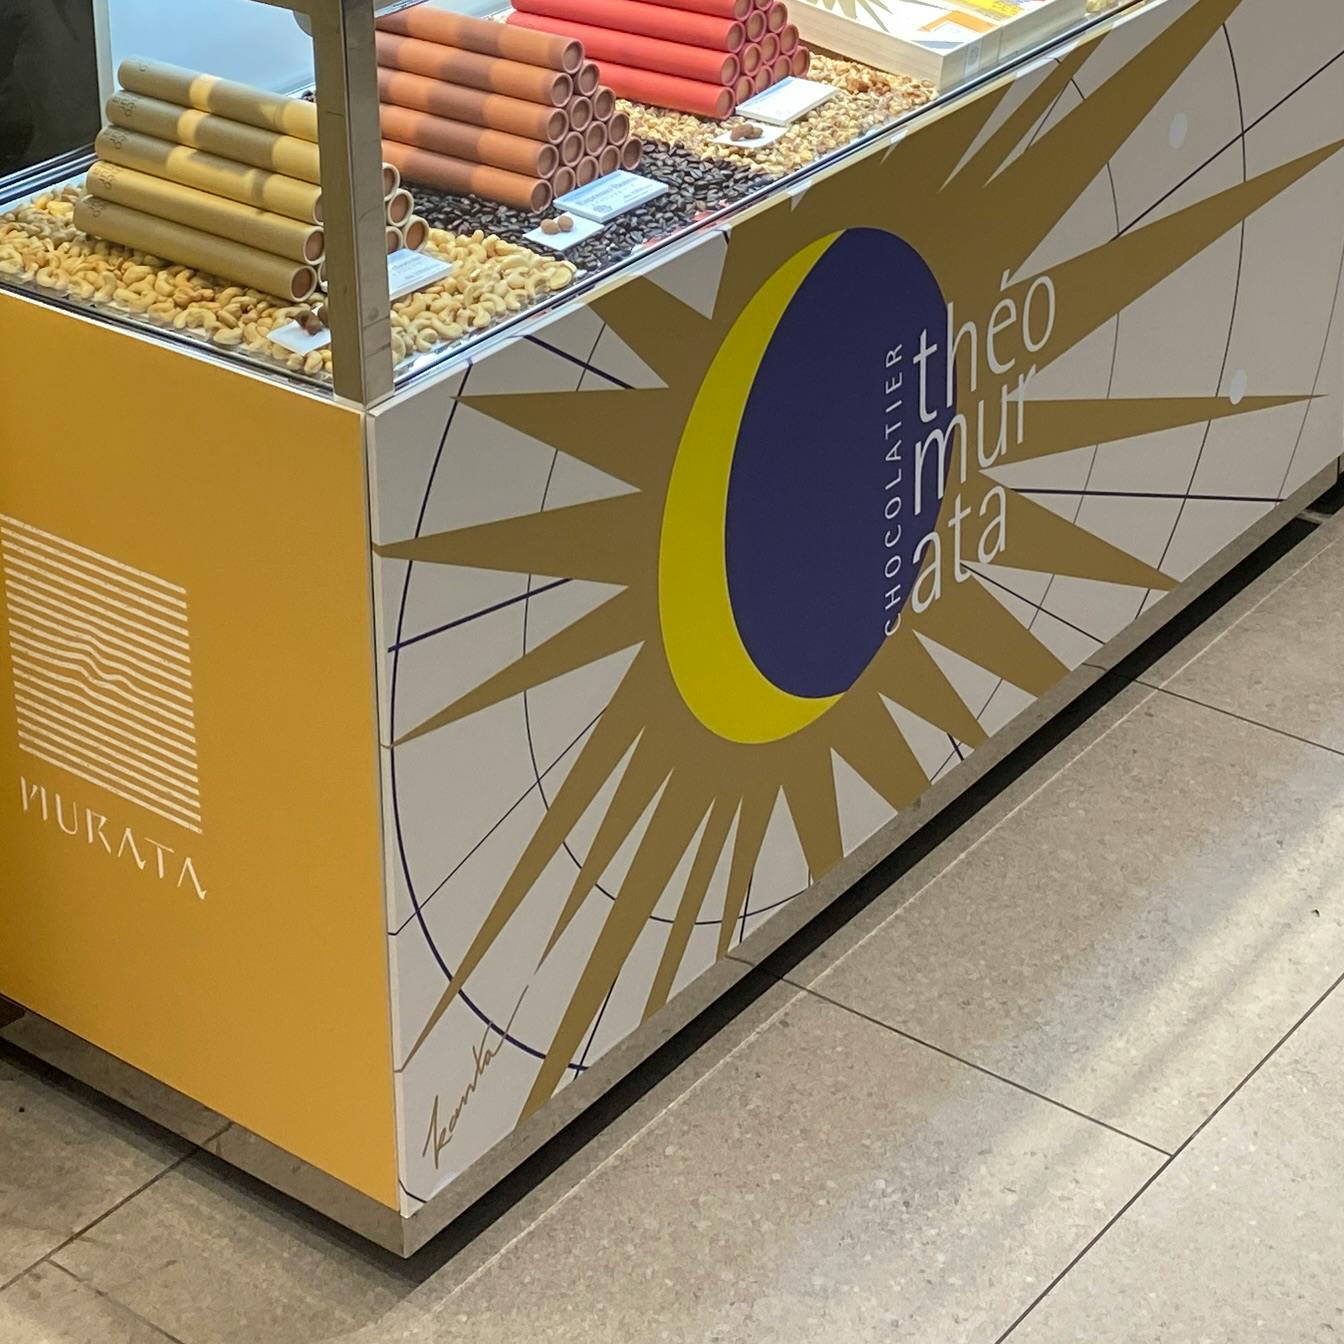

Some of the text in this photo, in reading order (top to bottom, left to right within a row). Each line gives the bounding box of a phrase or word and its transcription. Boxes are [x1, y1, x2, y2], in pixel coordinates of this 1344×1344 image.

[912, 268, 1056, 424] théo
[883, 342, 904, 638] CHOCOLATIER
[914, 364, 1037, 517] mur
[911, 484, 1007, 614] ata
[20, 775, 207, 901] MURATA
